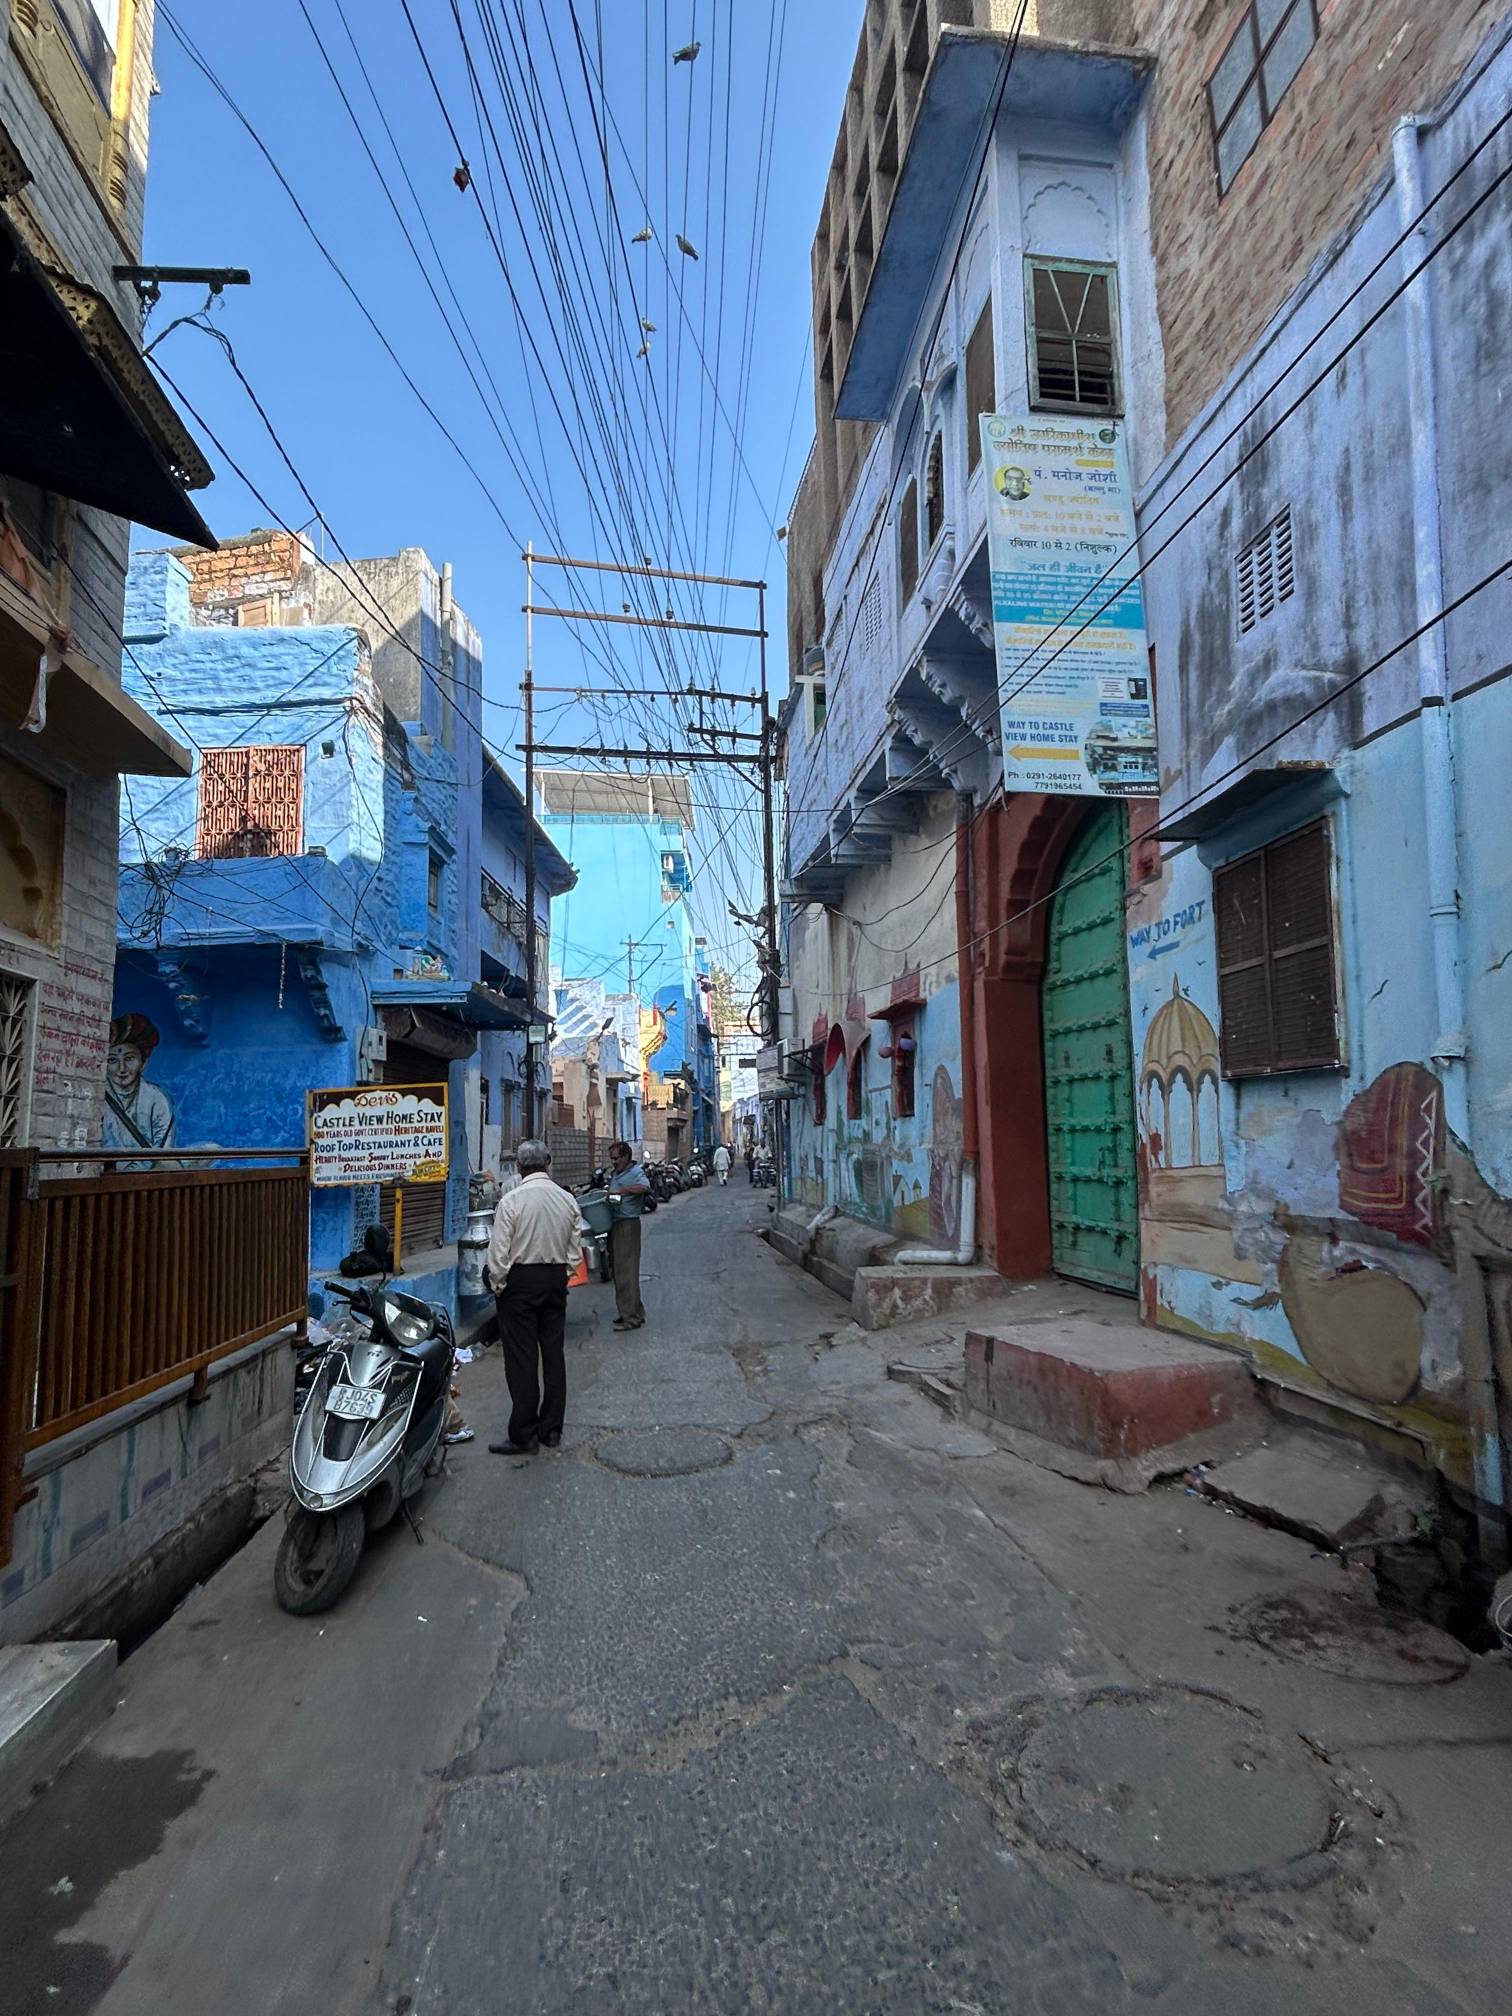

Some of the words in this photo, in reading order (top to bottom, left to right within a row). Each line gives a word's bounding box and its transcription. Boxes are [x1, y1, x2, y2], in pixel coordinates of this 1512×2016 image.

[1010, 424, 1025, 438] श्री
[1051, 467, 1082, 481] मनोज
[1086, 469, 1119, 483] जोशी
[1008, 537, 1039, 549] रविवार
[1041, 540, 1051, 550] 10
[1054, 538, 1063, 550] से
[1065, 541, 1072, 550] 2
[1064, 562, 1092, 574] जीवन
[1007, 720, 1026, 731] WAY
[1028, 720, 1040, 731] TO
[1042, 721, 1075, 732] CASTLE
[1005, 732, 1029, 742] VIEW
[1030, 733, 1055, 743] HOME
[1057, 734, 1079, 744] STAY
[1008, 771, 1019, 780] Ph
[1130, 925, 1152, 949] WAY
[1152, 918, 1170, 943] TO
[1173, 899, 1206, 933] FORT
[314, 1115, 355, 1129] CASTLE
[357, 1112, 385, 1126] VIEW
[386, 1110, 415, 1125] HOME
[417, 1109, 443, 1123] STAY
[326, 1130, 342, 1138] YEARS
[343, 1129, 353, 1137] OLD
[368, 1127, 393, 1136] CERTIFIED
[394, 1125, 424, 1136] HERITAGE
[425, 1124, 443, 1134] HAVELI
[314, 1142, 336, 1153] ROOF
[337, 1140, 354, 1152] TOP
[354, 1137, 412, 1151] RESTAURANT
[413, 1135, 420, 1147] &
[421, 1135, 443, 1147] CAFE
[391, 1151, 421, 1160] LUNCHES
[424, 1149, 443, 1159] AND
[343, 1162, 376, 1173] DELICIOUS
[377, 1161, 408, 1171] DINNERS
